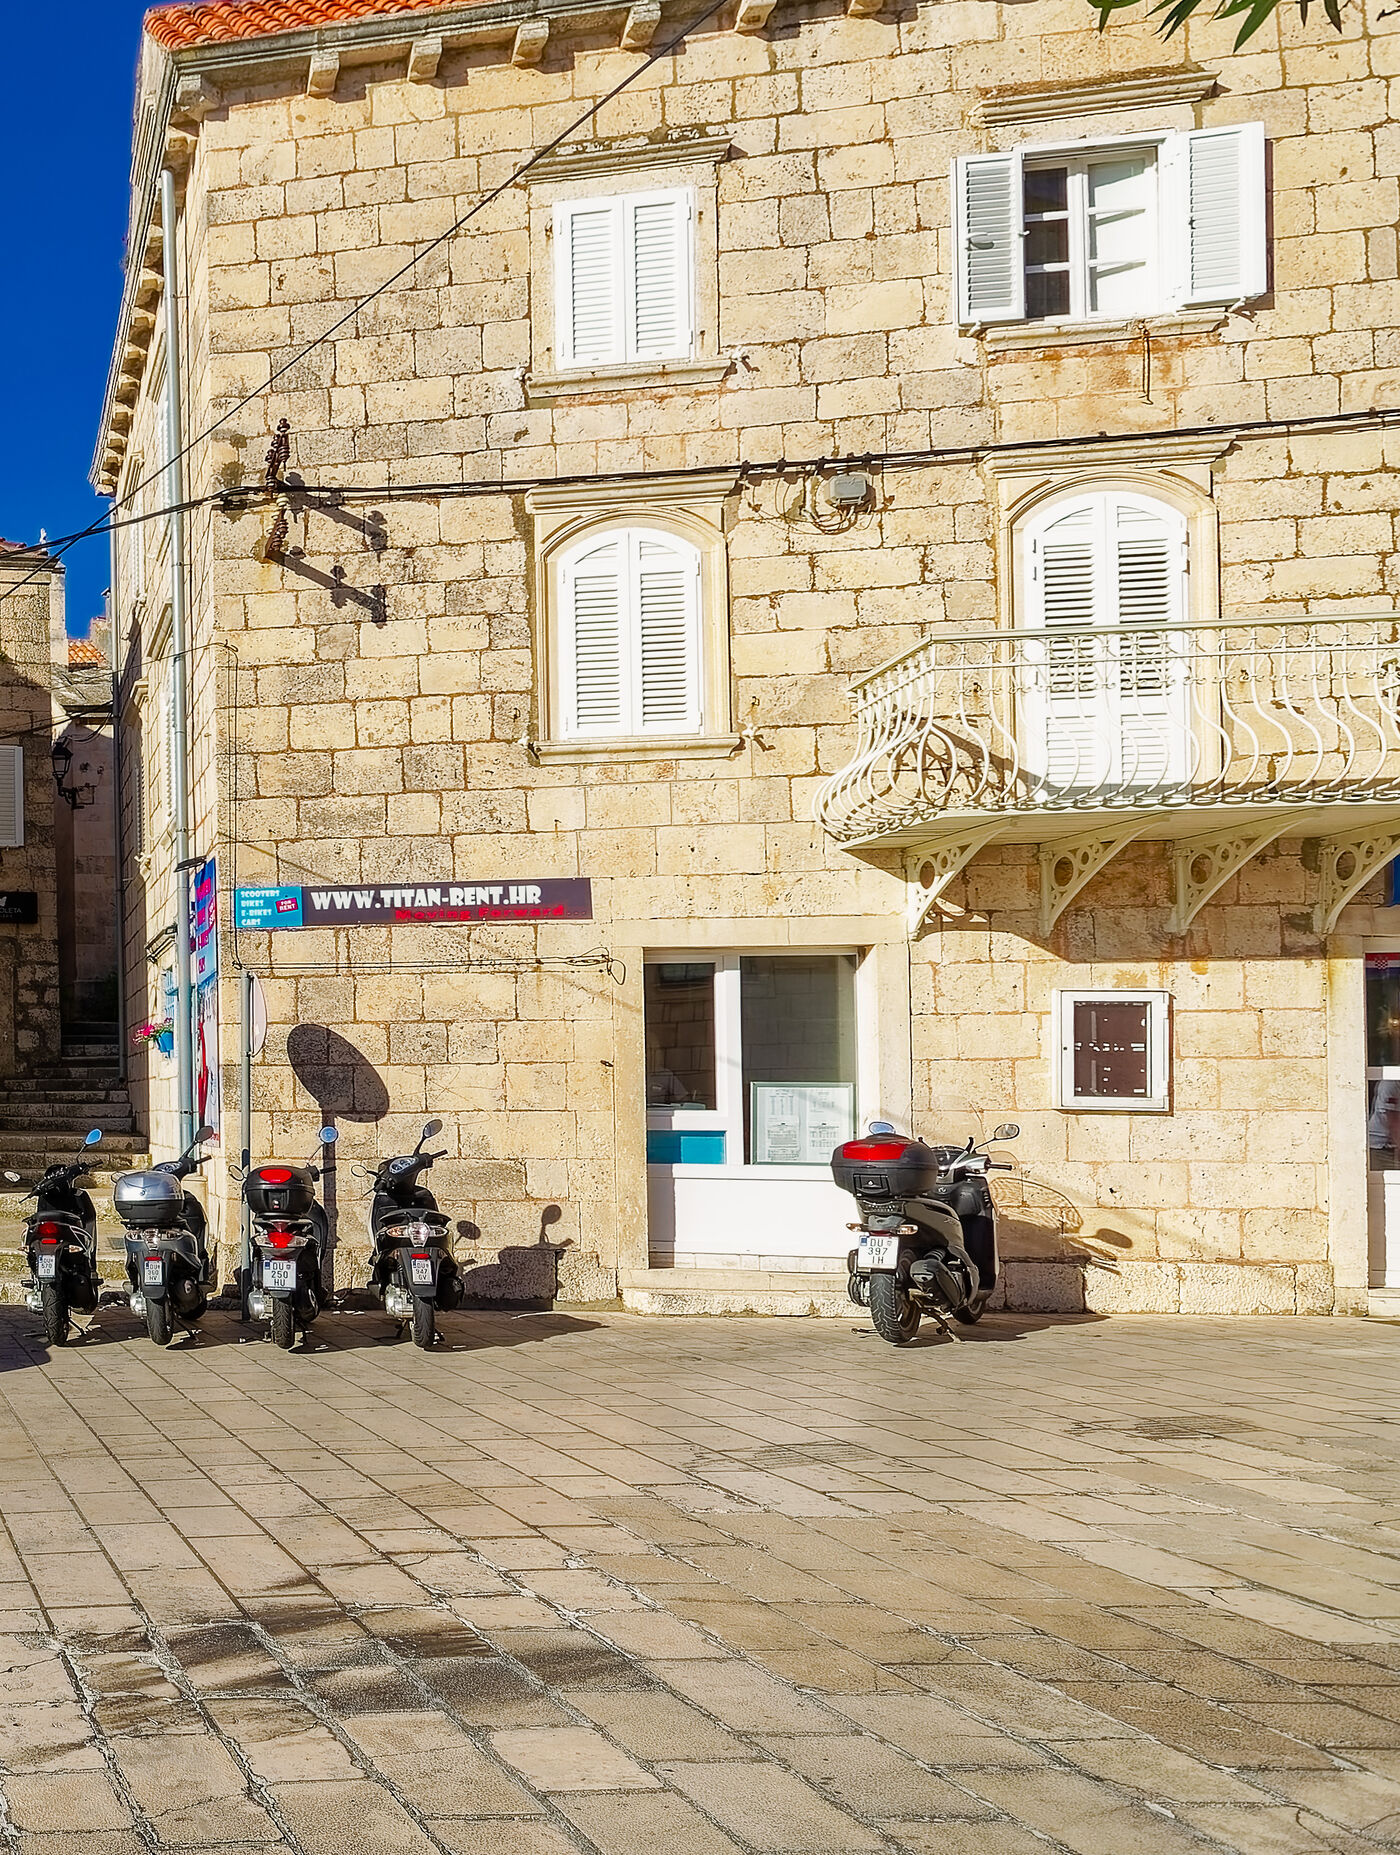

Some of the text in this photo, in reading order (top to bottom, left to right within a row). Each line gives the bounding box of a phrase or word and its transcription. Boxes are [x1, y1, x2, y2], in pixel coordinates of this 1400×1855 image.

[240, 890, 280, 898] SCOOTERS
[310, 885, 542, 910] WWW.TITAN-RENT.HR
[395, 906, 471, 921] Moving
[870, 1238, 884, 1247] DU
[868, 1247, 888, 1256] 397
[271, 1270, 288, 1279] 250
[273, 1278, 286, 1287] HU
